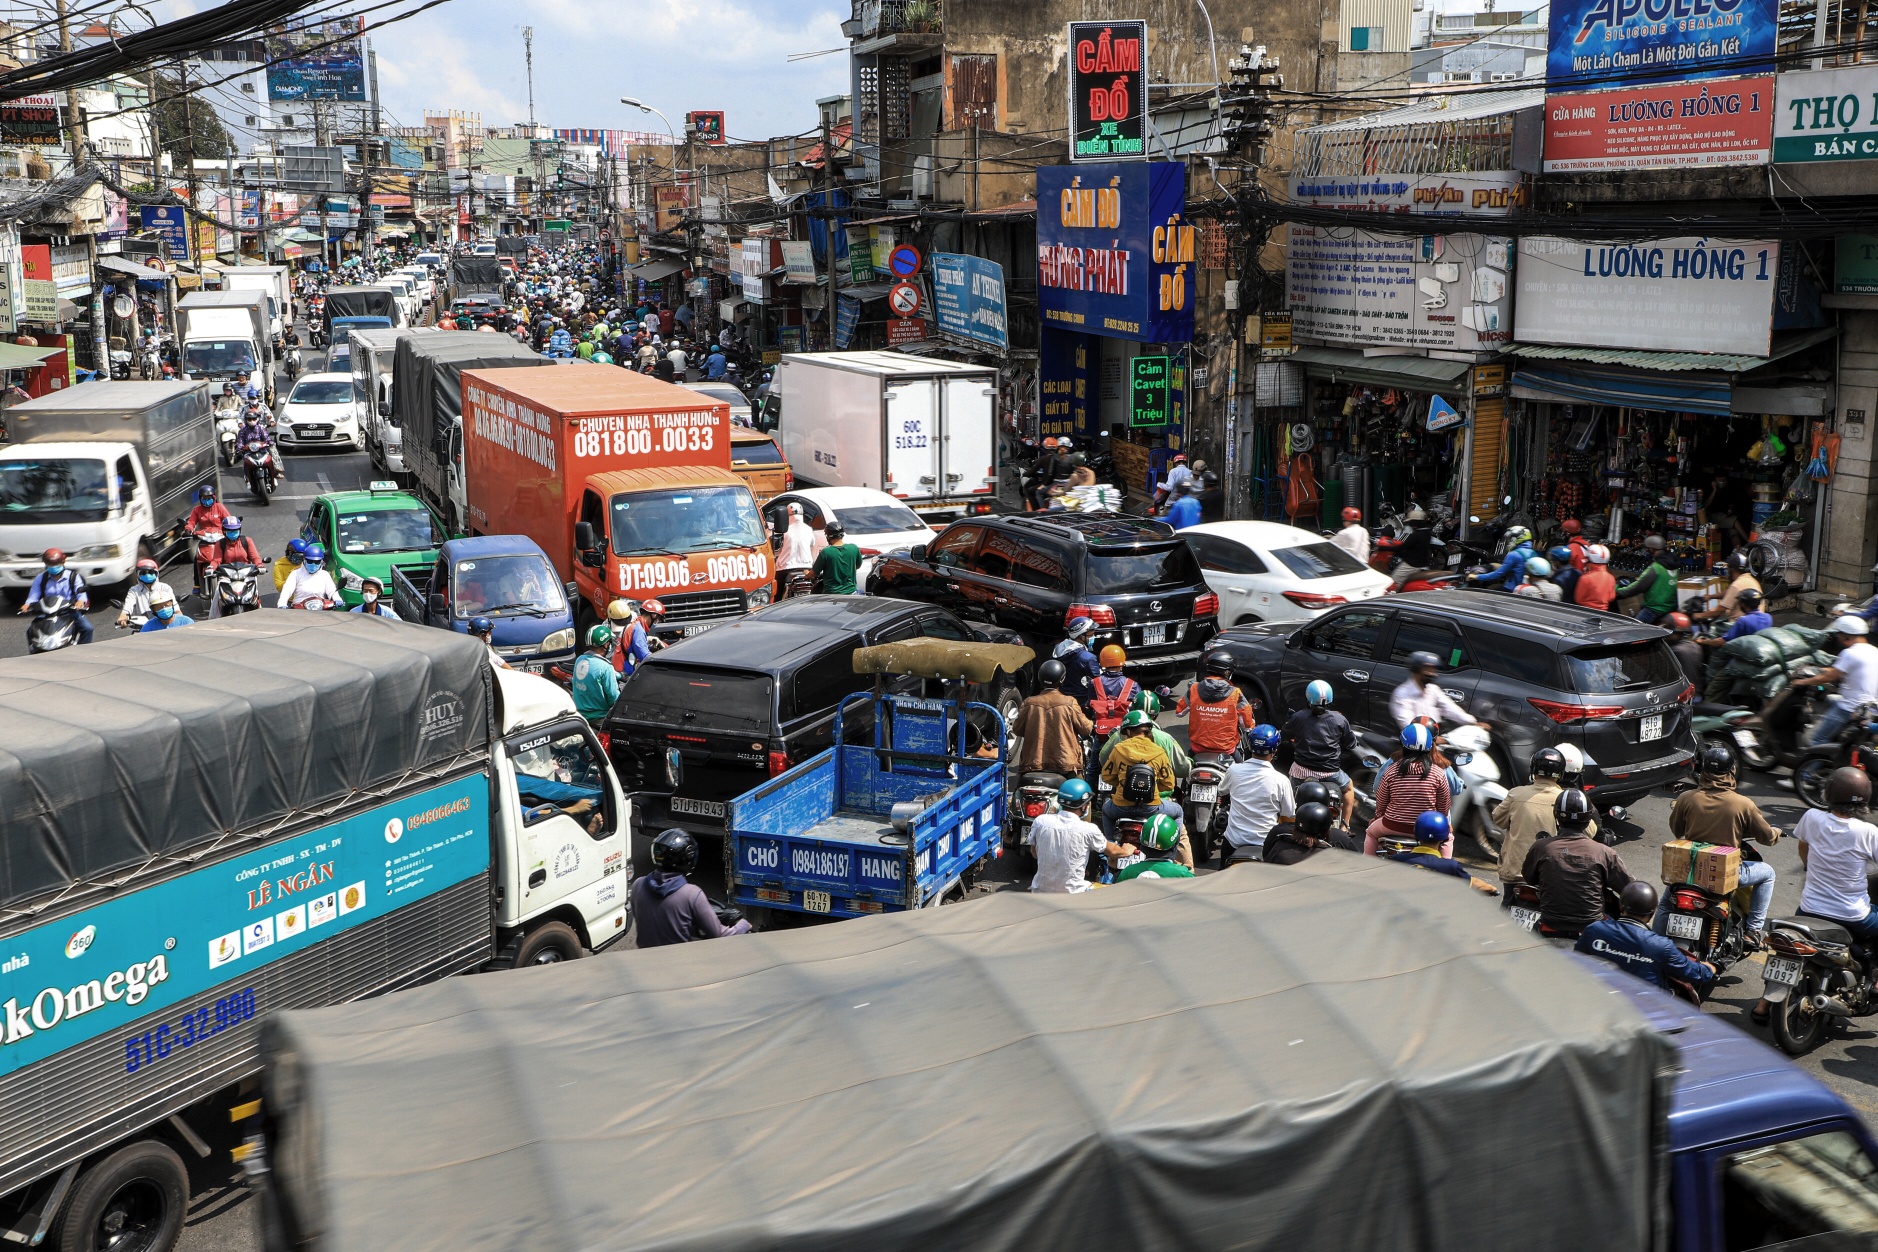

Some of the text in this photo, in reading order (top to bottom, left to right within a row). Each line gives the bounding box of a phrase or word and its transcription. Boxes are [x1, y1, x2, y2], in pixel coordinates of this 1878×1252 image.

[1605, 14, 1743, 41] SILICONE SEALANT
[1077, 28, 1139, 74] CẦM
[1573, 36, 1740, 74] Một Lần Chạm Là Một Đời Gắn Kết
[1089, 75, 1130, 121] ĐỒ
[1552, 86, 1760, 123] CỬA HÀNG LƯƠNG HỒNG 1
[21, 110, 55, 121] SHOP
[1788, 94, 1860, 134] THỌ
[1100, 122, 1117, 136] XE
[1814, 137, 1857, 155] BÁN
[1392, 181, 1408, 198] HỢP
[1152, 213, 1195, 264] CẦM
[1085, 239, 1130, 296] PHÁT
[1584, 236, 1769, 281] LƯƠNG HỒNG 1
[1160, 263, 1187, 311] ĐỒ
[1043, 379, 1071, 395] CÁC LOẠI
[1134, 378, 1165, 389] Cavet
[1045, 399, 1060, 415] GIẤY
[1146, 393, 1153, 404] 3
[1135, 408, 1163, 421] Triệu
[904, 420, 921, 433] 60C
[1051, 420, 1062, 435] GIÁ
[896, 435, 927, 449] 518.22
[706, 553, 767, 584] 0606.90
[1148, 627, 1160, 636] 51A
[425, 701, 458, 725] HUY
[1196, 705, 1229, 714] LALAMOVE
[520, 735, 551, 752] ISUZU
[407, 796, 471, 831] 0948066463
[235, 838, 343, 883] CÔNG TY TNHH SX TM DV
[604, 850, 622, 864] ISUZU
[747, 839, 900, 881] CHỞ HANG
[247, 860, 335, 911] LÊ NGÂN
[807, 901, 828, 912] 1267
[1673, 916, 1697, 929] 54-P9
[1592, 938, 1654, 964] Champion
[2, 952, 30, 974] nhà
[1768, 969, 1793, 983] 1092
